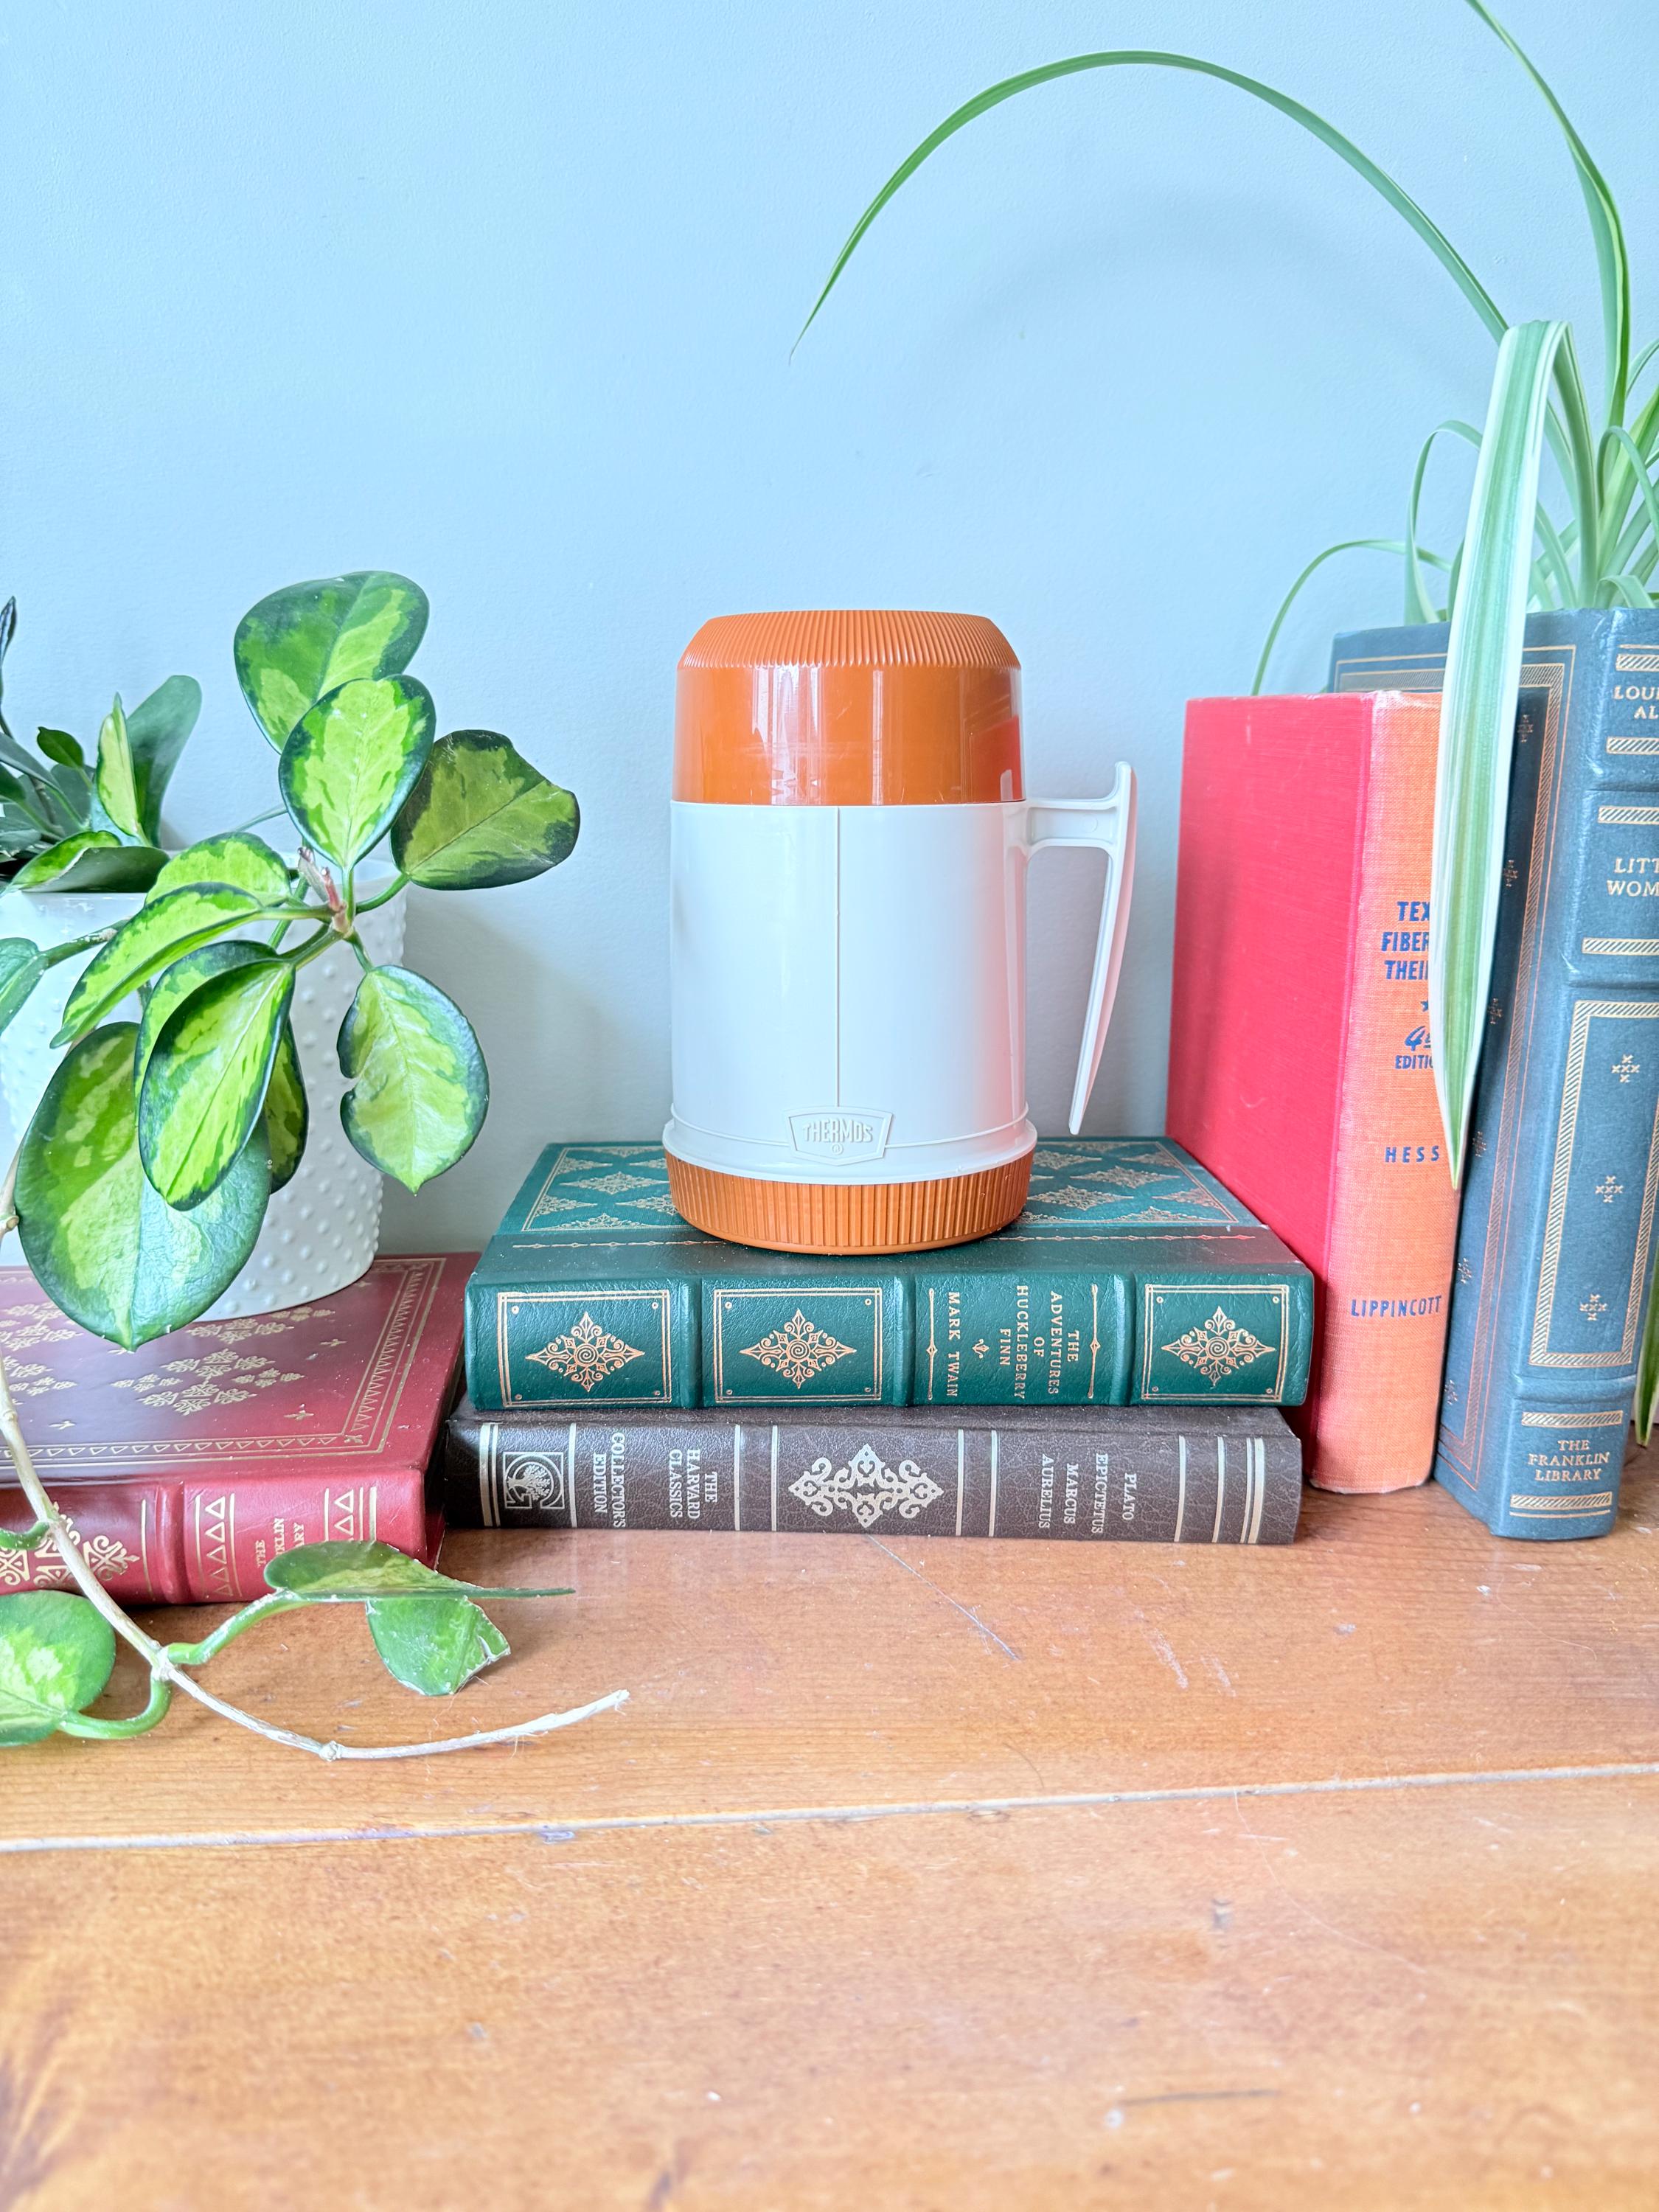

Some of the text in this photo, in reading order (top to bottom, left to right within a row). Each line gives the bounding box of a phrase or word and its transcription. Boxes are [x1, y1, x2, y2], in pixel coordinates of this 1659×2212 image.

[803, 1118, 874, 1143] THERMOS
[1385, 1145, 1440, 1164] HESS
[1351, 1295, 1442, 1318] LIPPINCOTT
[946, 1291, 961, 1397] MARK TWAIN
[999, 1328, 1012, 1366] FINN
[1014, 1285, 1029, 1399] HUCKLEBERRY
[1033, 1336, 1046, 1357] OF
[1048, 1290, 1063, 1395] ADVENTURES
[1067, 1329, 1080, 1363] THE
[1528, 1451, 1610, 1467] FRANKLIN
[1557, 1439, 1591, 1452] THE
[593, 1452, 608, 1514] EDITION
[611, 1432, 627, 1528] COLLECTOR'S
[668, 1448, 684, 1519] CLASSICS
[686, 1449, 701, 1520] HARVARD
[704, 1472, 718, 1504] THE
[1038, 1453, 1054, 1529] AURELIUS
[1063, 1463, 1079, 1525] MARCUS
[1091, 1453, 1109, 1534] EPICTETUS
[1534, 1467, 1602, 1482] LIBRARY
[1122, 1472, 1138, 1521] PLATO
[254, 1539, 267, 1569] THE
